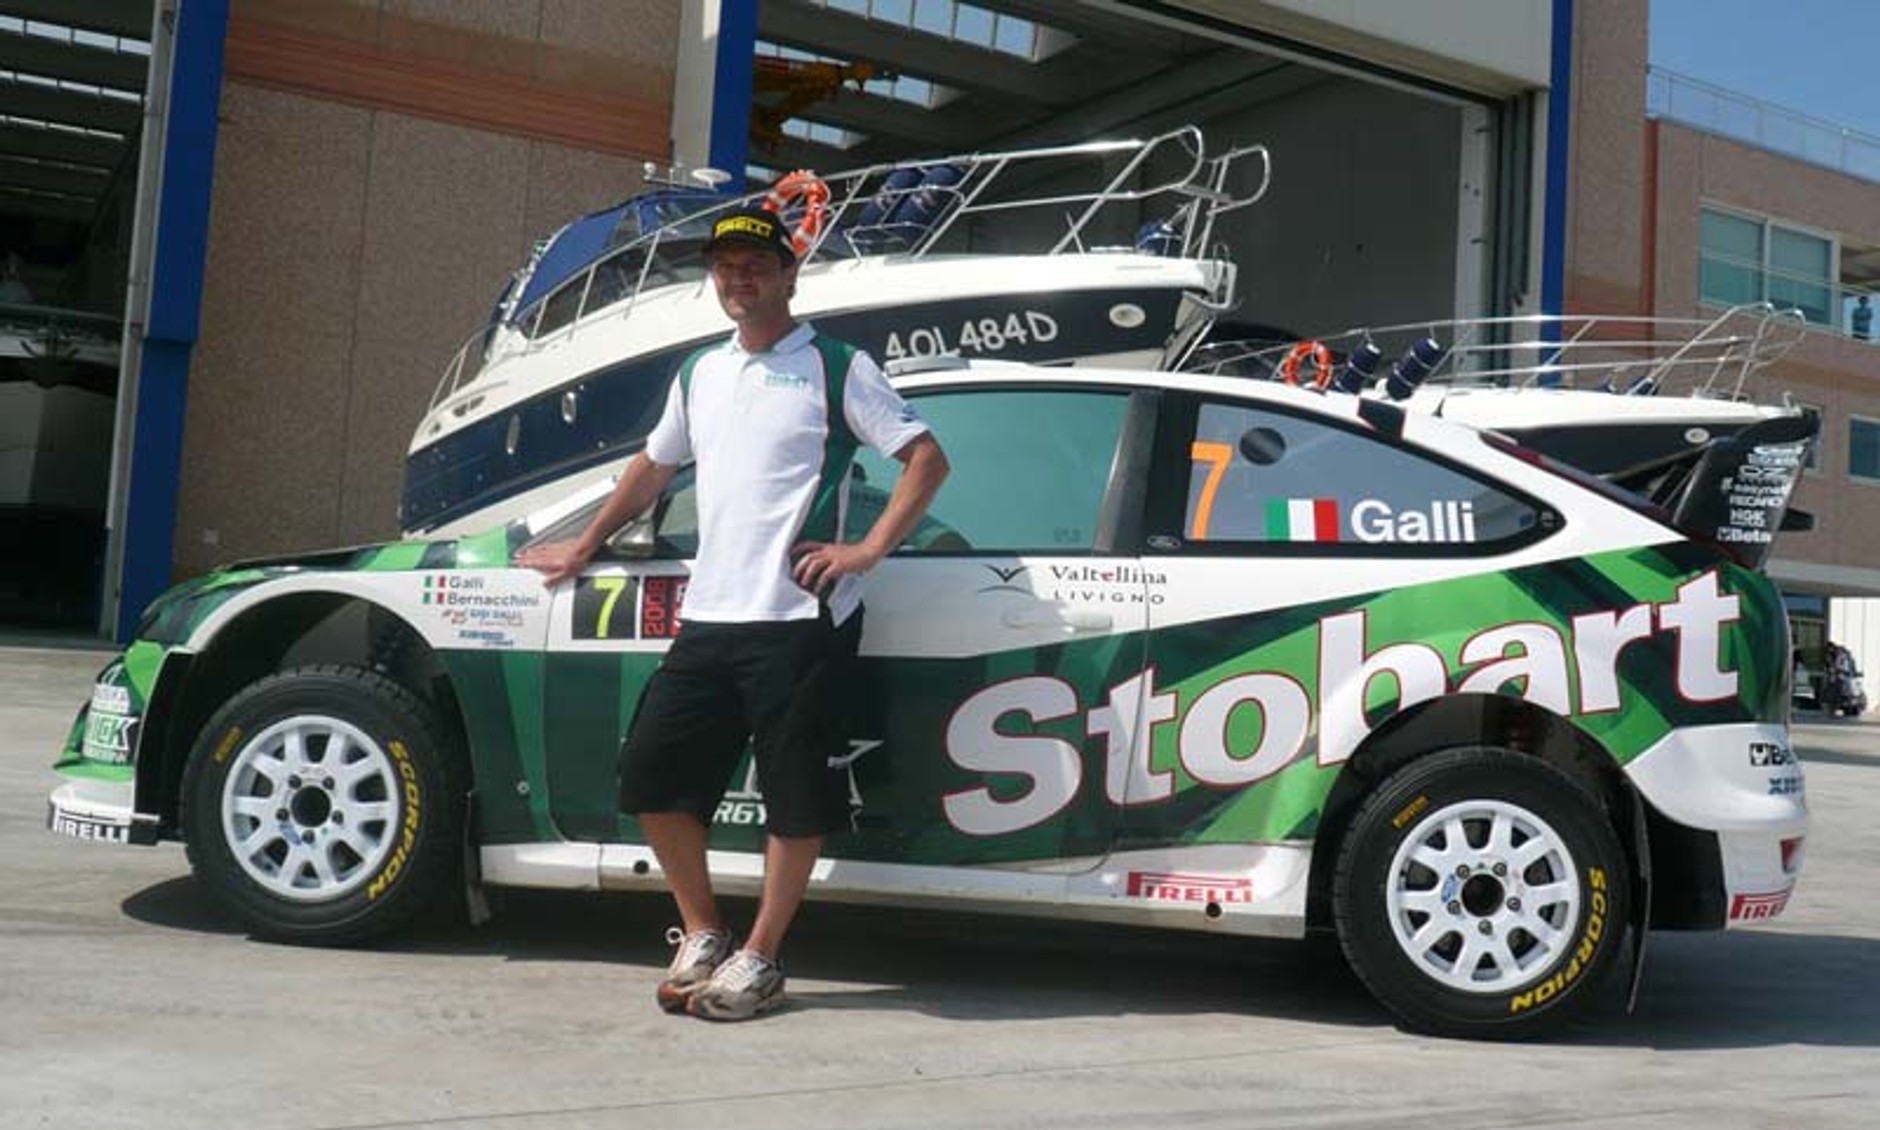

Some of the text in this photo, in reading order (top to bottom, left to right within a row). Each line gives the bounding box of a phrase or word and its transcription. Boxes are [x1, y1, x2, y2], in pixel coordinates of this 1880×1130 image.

[1190, 442, 1234, 540] 7
[1350, 499, 1476, 543] Galli
[448, 576, 483, 589] Galli
[1050, 565, 1168, 585] Valtellina
[447, 592, 540, 607] Bernacchini
[594, 577, 628, 638] 7
[1054, 590, 1165, 605] LIVIGNO
[942, 569, 1740, 836] Stobart
[367, 740, 420, 900] SCORPION
[1127, 871, 1253, 903] PIRELLI
[1510, 867, 1607, 1012] SCORPION
